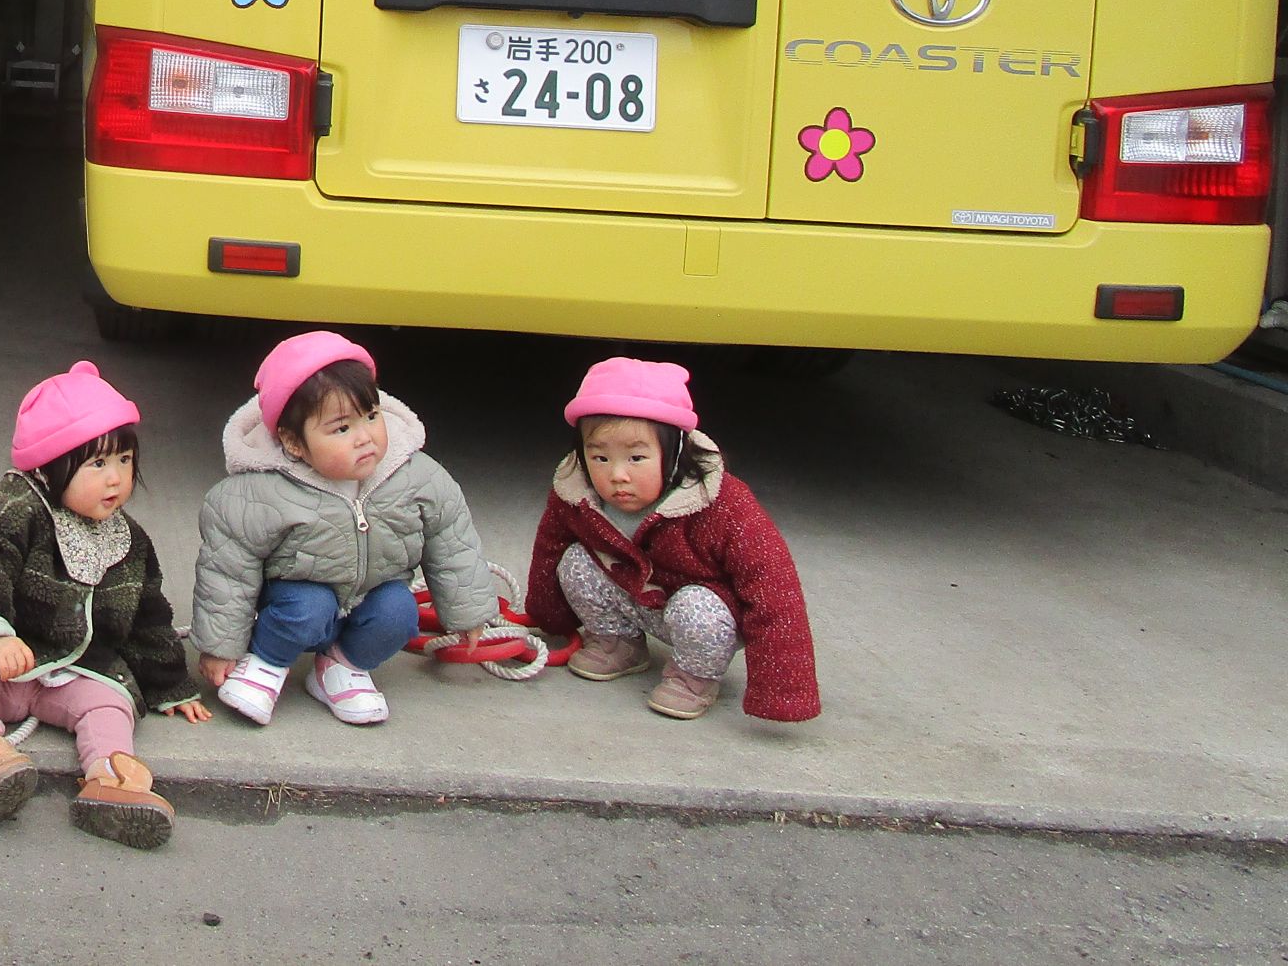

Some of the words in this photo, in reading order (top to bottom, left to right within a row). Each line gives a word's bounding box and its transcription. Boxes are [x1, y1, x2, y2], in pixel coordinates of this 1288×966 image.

[506, 35, 612, 65] 岩手200
[784, 38, 1081, 78] COASTER
[473, 77, 490, 104] さ
[501, 67, 644, 123] 24-08
